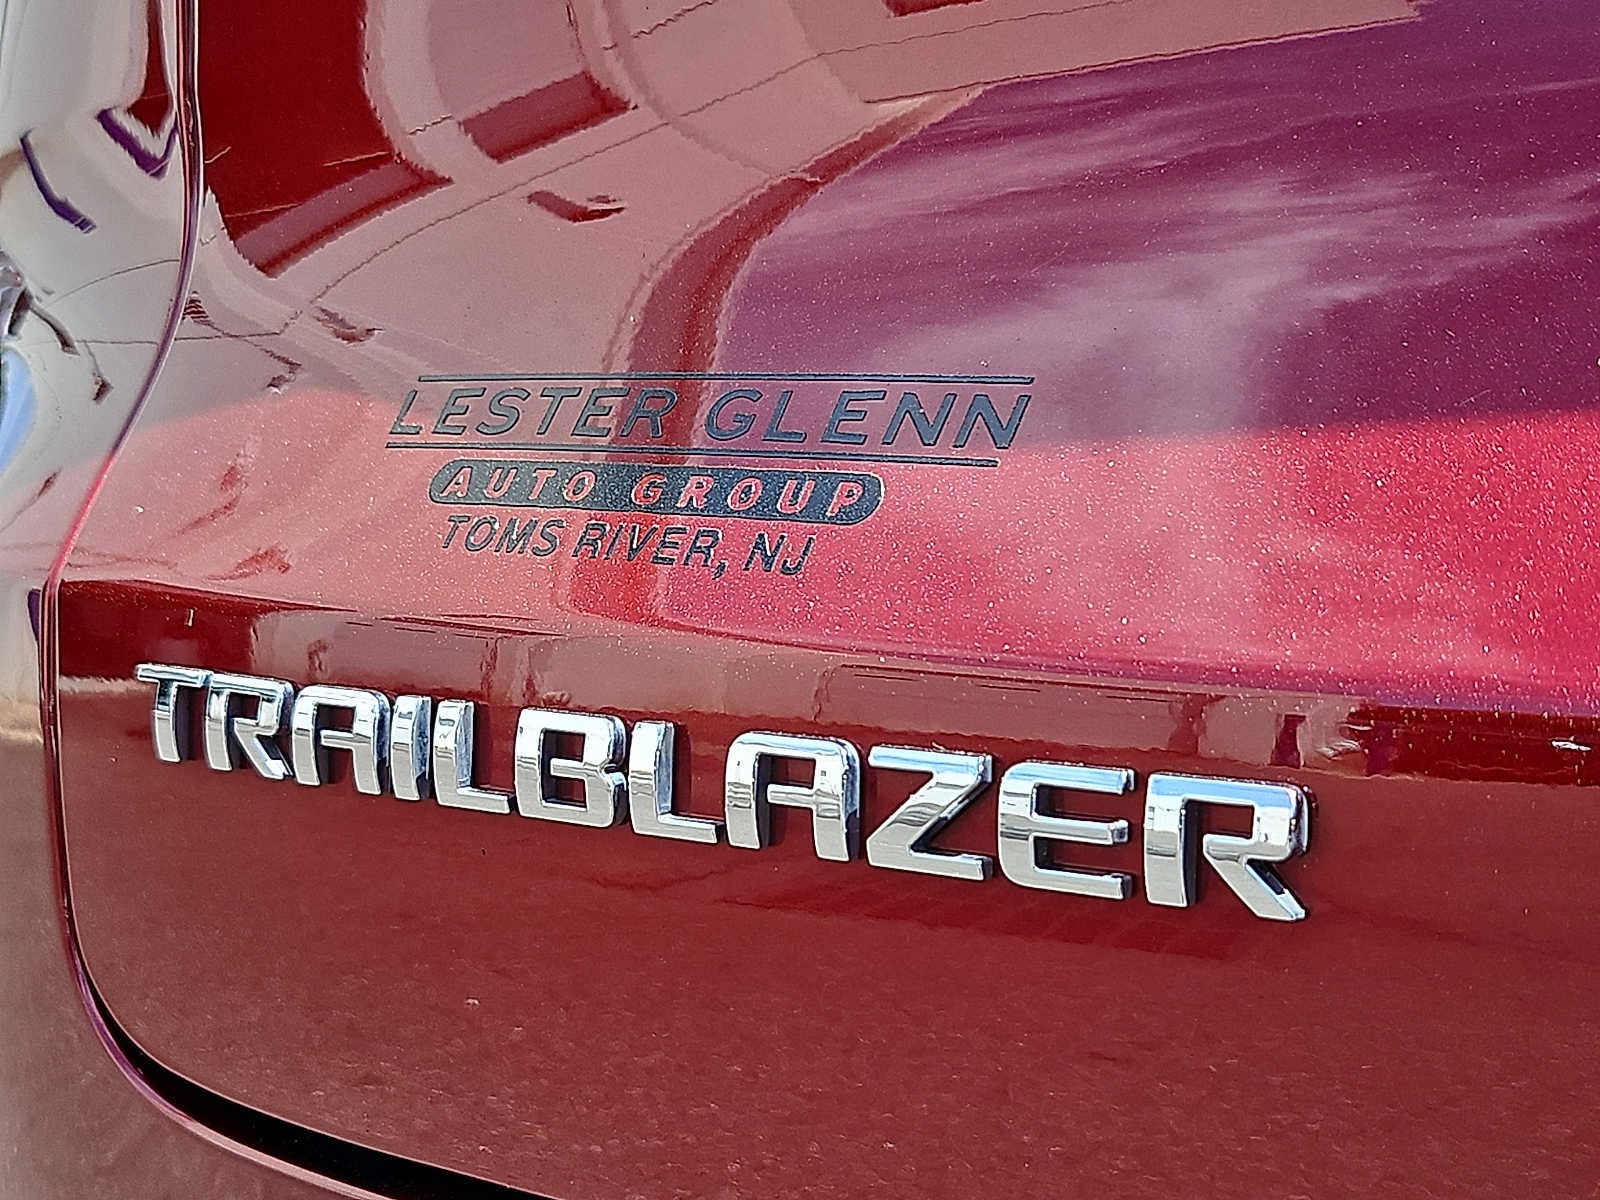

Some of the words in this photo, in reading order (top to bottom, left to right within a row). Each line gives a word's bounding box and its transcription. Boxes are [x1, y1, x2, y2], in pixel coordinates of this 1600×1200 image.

[389, 386, 679, 438] LESTER
[704, 389, 1032, 449] GLENN
[440, 466, 598, 501] AUTO
[631, 472, 864, 518] GROUP
[441, 514, 565, 557] TOMS
[571, 522, 727, 580] RIVER,
[743, 532, 815, 576] NJ
[135, 661, 1312, 922] TRAILBLAZER
